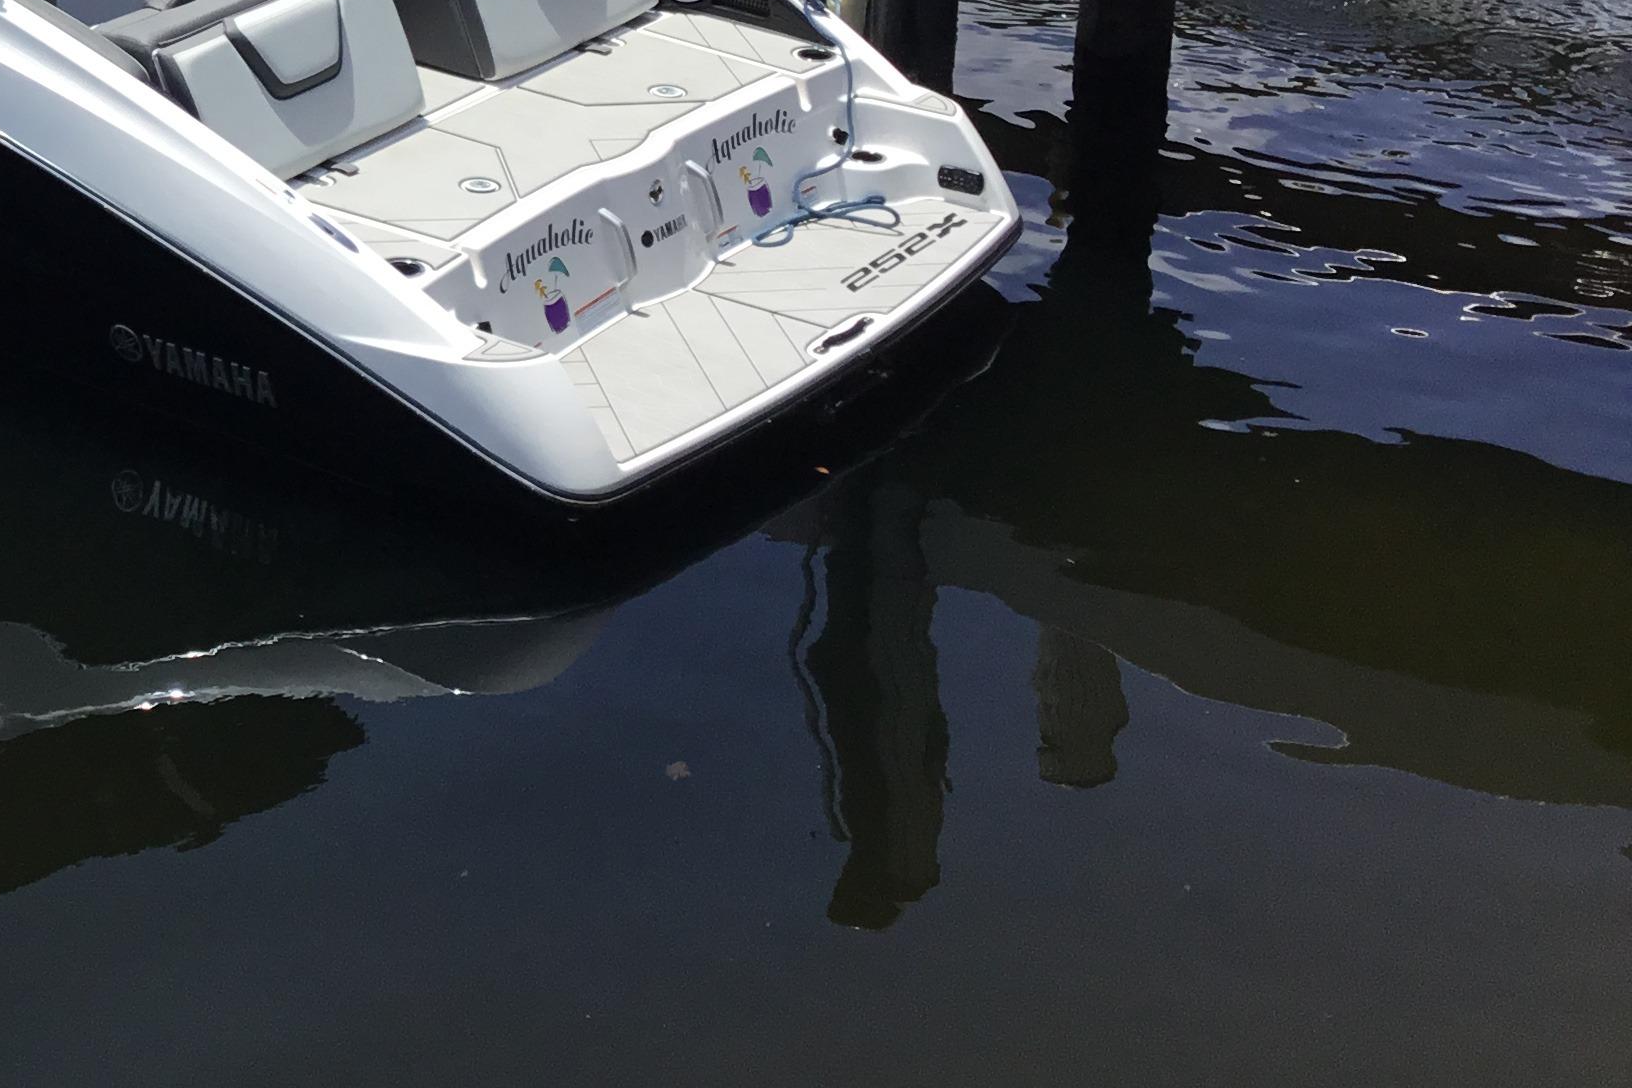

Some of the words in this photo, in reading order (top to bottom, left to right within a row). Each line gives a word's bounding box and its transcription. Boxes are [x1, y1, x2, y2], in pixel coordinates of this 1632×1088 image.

[706, 109, 796, 175] Aquaholic
[499, 218, 593, 294] Aquaholic
[840, 212, 968, 292] 252X
[142, 334, 279, 408] YAMAHA
